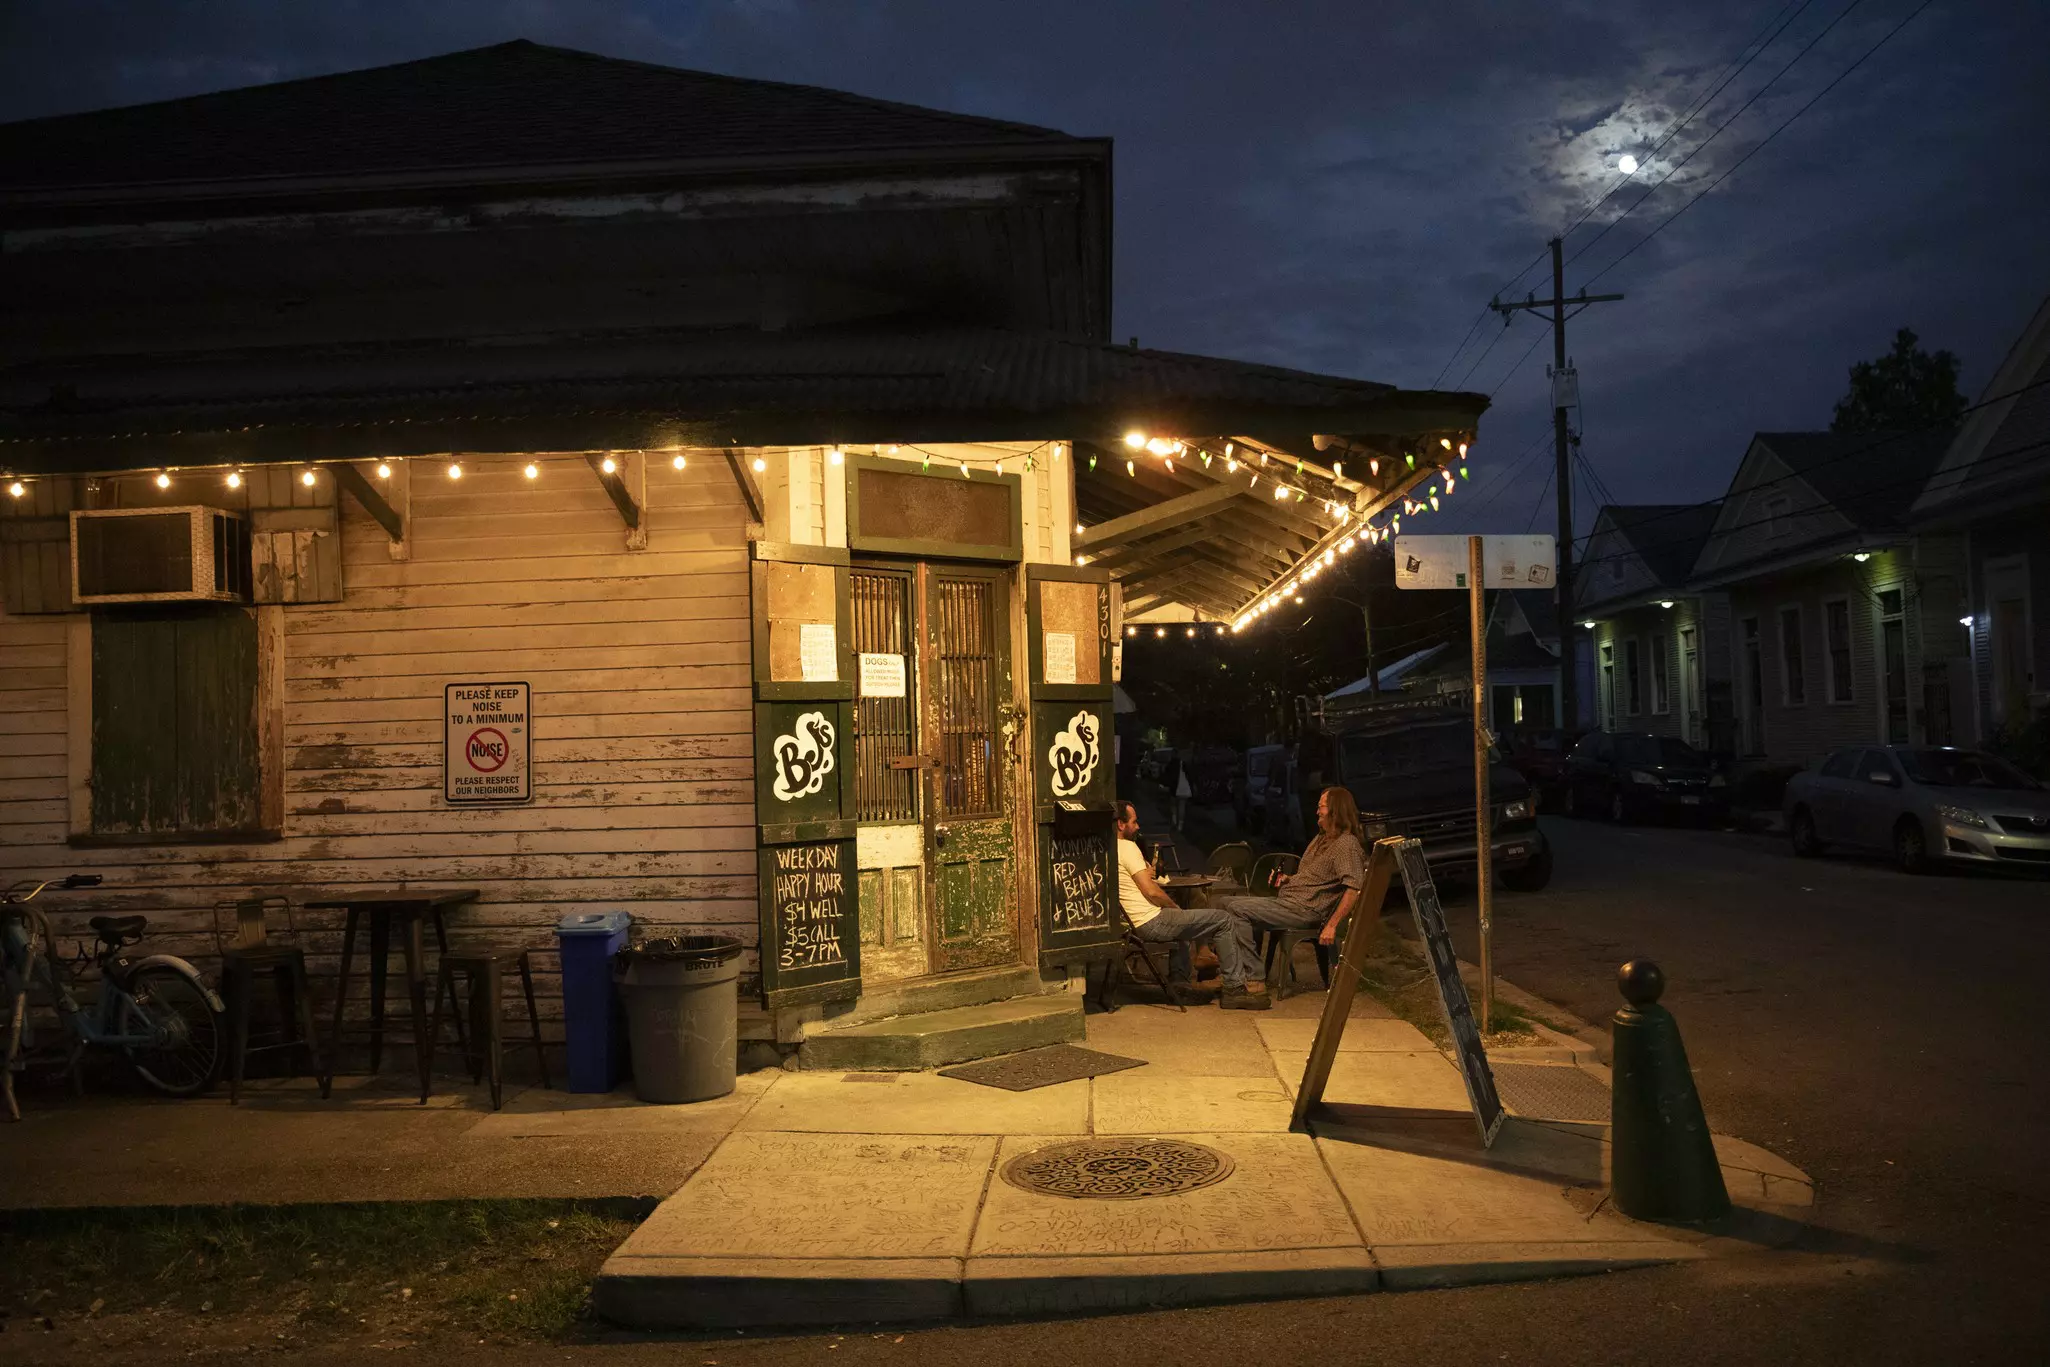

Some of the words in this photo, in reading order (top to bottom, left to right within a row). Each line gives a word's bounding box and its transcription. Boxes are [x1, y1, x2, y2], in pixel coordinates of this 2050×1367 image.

[1099, 588, 1108, 657] 4301
[865, 657, 888, 666] DOGS
[455, 689, 491, 700] PLEASE
[494, 689, 519, 699] KEEP
[472, 701, 502, 712] NOISE
[451, 714, 463, 724] TO
[466, 714, 473, 724] A
[476, 713, 524, 723] MINIMUM
[471, 743, 503, 758] NOISE
[455, 776, 485, 785] PLEASE
[485, 776, 520, 784] RESPECT
[455, 786, 472, 795] OUR
[474, 785, 519, 794] NEIGHBORS
[1053, 862, 1076, 885] RED
[776, 873, 810, 904] HAPPY
[815, 872, 844, 897] HOUR
[1063, 864, 1103, 899] BEANS
[785, 900, 805, 924] $4
[810, 898, 844, 919] WELL
[1065, 892, 1105, 924] BLUES
[786, 925, 809, 947] $5
[810, 924, 840, 942] CALL
[685, 960, 724, 971] BRUTE
